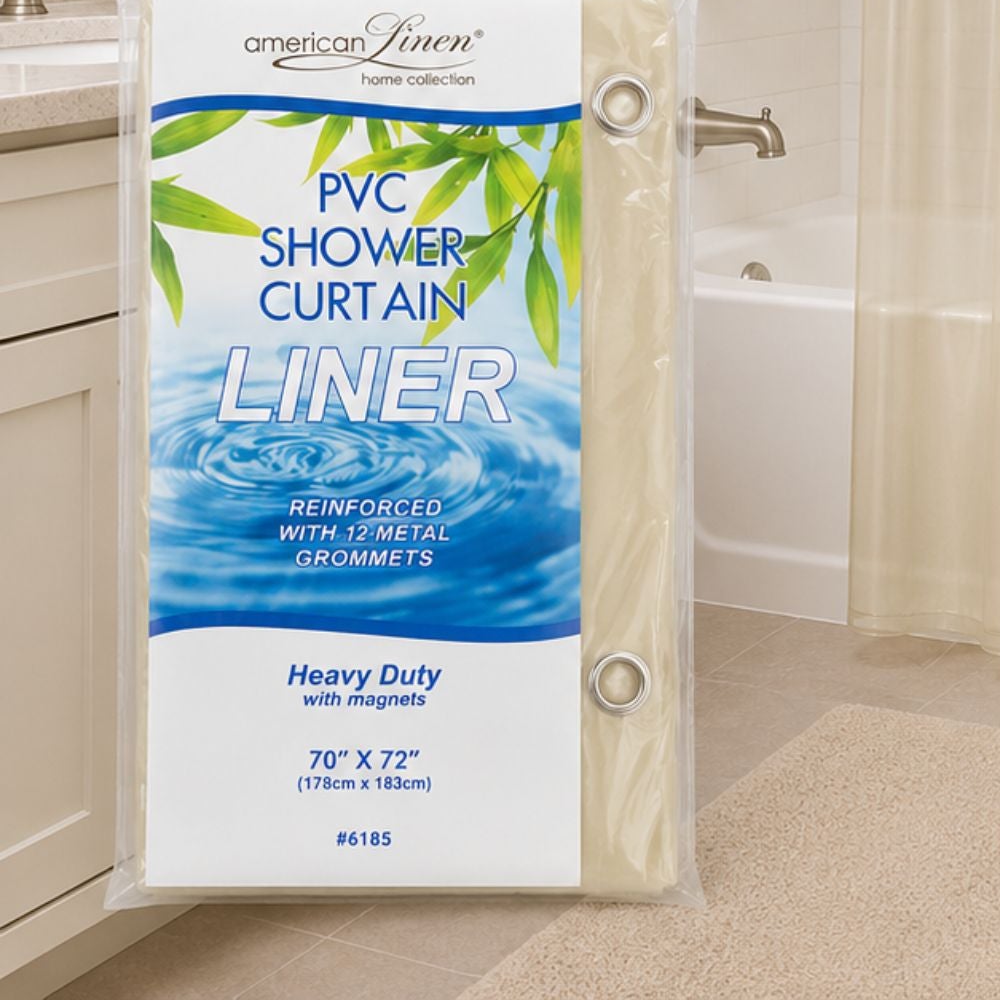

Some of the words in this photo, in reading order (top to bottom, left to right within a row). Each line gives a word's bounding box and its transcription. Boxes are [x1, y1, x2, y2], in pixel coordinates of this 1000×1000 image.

[244, 32, 365, 53] american
[361, 72, 401, 86] home
[406, 72, 475, 86] collection
[318, 172, 407, 214] PVC
[259, 226, 466, 268] SHOWER
[259, 281, 466, 322] CURTAIN
[216, 346, 517, 424] LINER
[288, 498, 442, 517] REINFORCED
[279, 524, 337, 542] WITH
[346, 524, 369, 542] 12
[375, 524, 450, 542] METAL
[295, 549, 434, 568] GROMMETS
[287, 664, 372, 691] Heavy
[379, 664, 442, 691] Duty
[303, 692, 341, 706] with
[347, 692, 426, 710] magnets
[355, 749, 373, 770] X
[297, 776, 355, 793] (178cm
[360, 779, 369, 790] x
[375, 776, 432, 793] 183cm)
[336, 831, 392, 846] #6185
